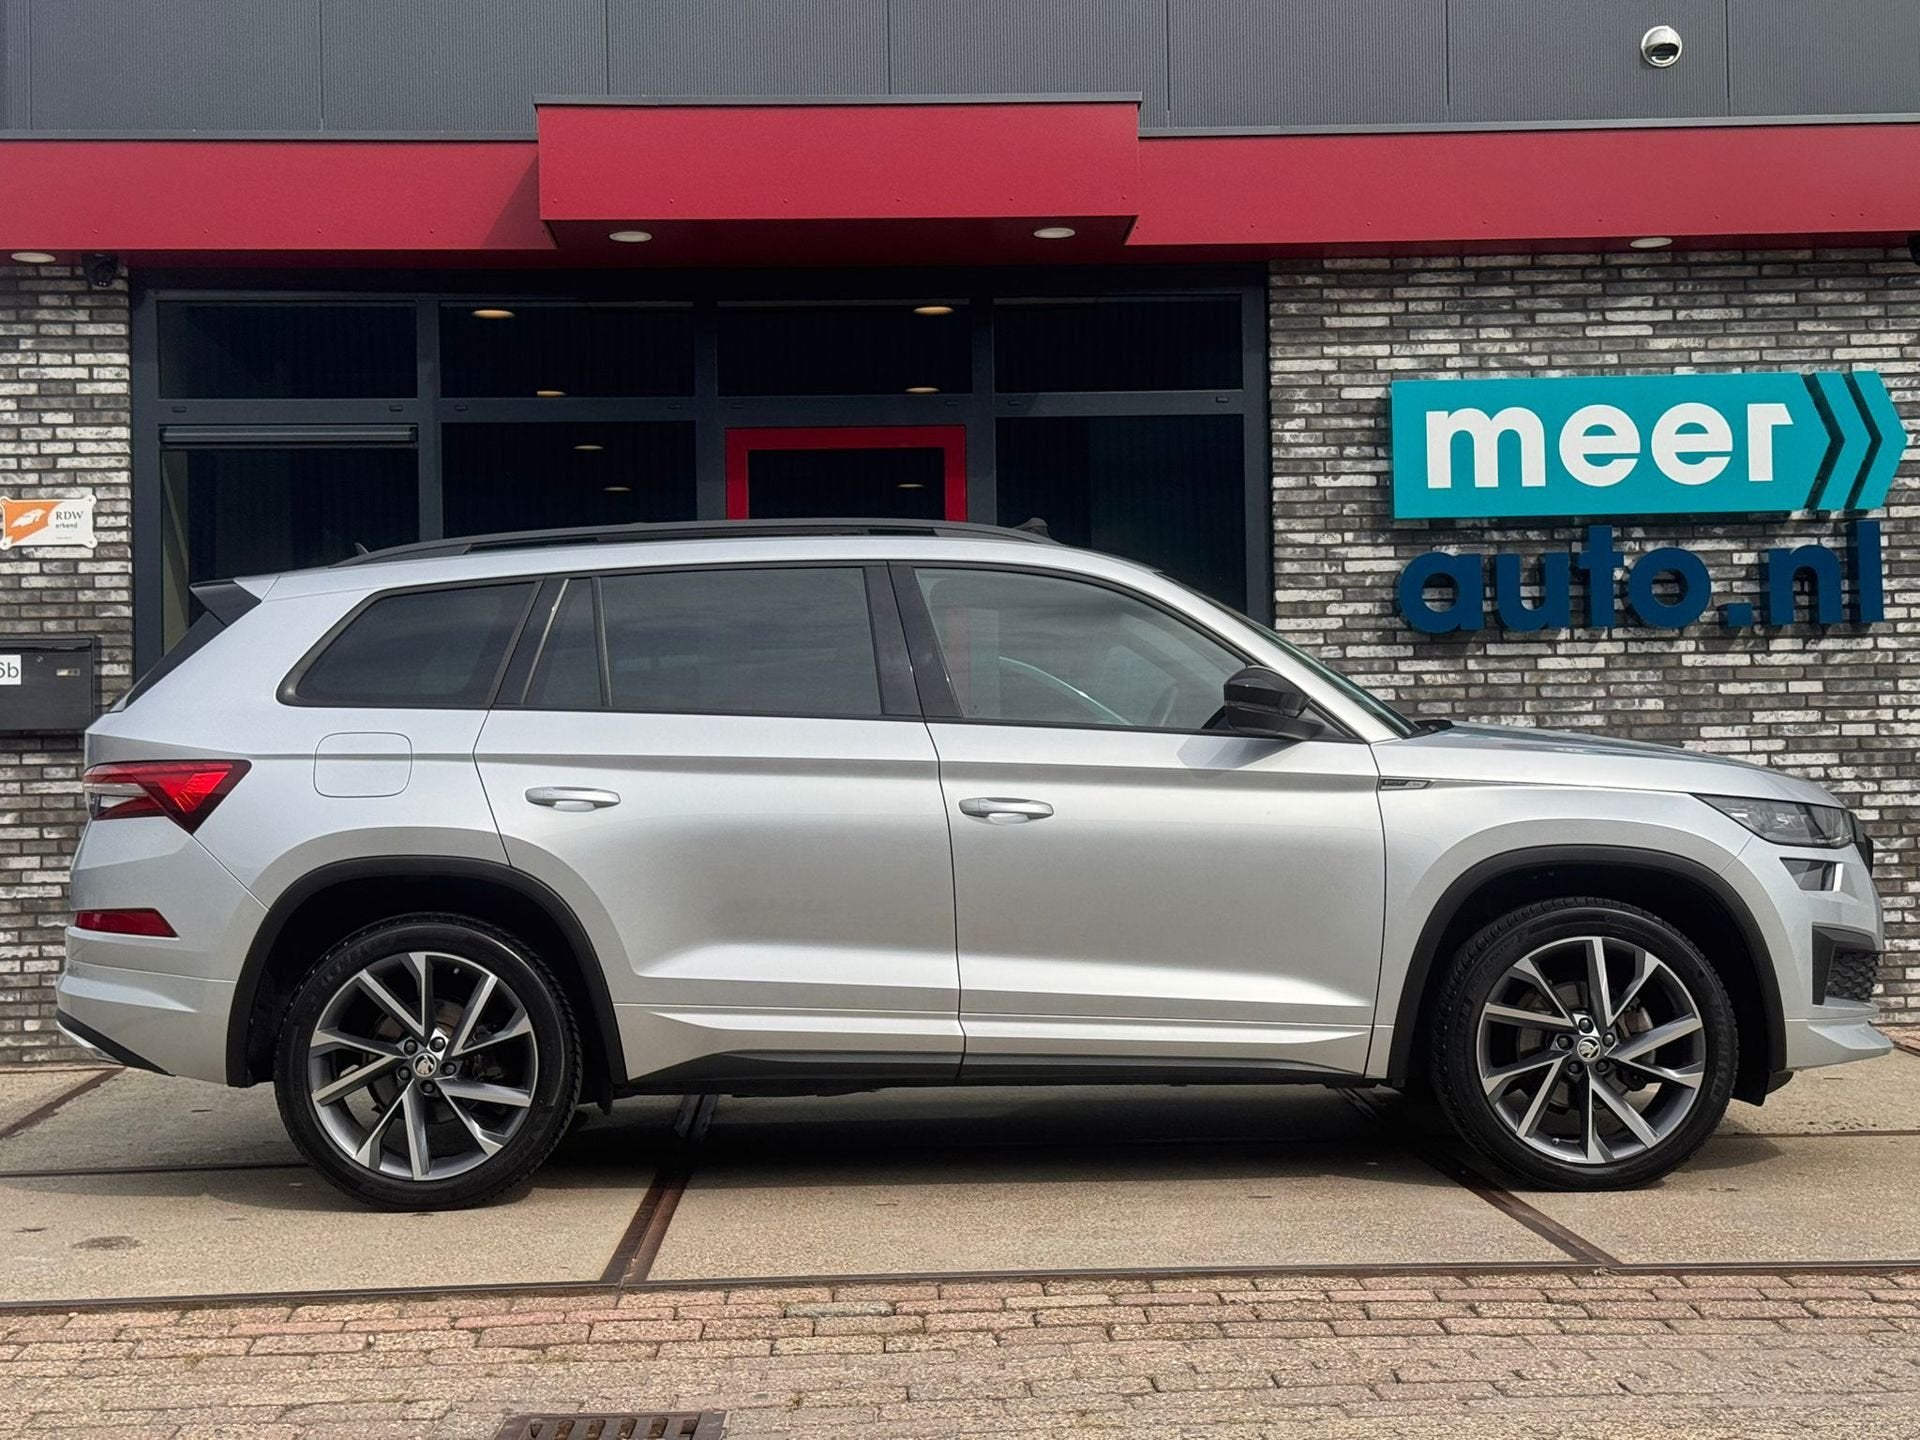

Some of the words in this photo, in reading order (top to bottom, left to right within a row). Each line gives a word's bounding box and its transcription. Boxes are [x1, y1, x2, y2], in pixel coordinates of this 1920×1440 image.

[1426, 402, 1794, 489] meer
[55, 510, 84, 520] RDW
[55, 521, 78, 529] erkend
[1396, 520, 1884, 634] auto.nl
